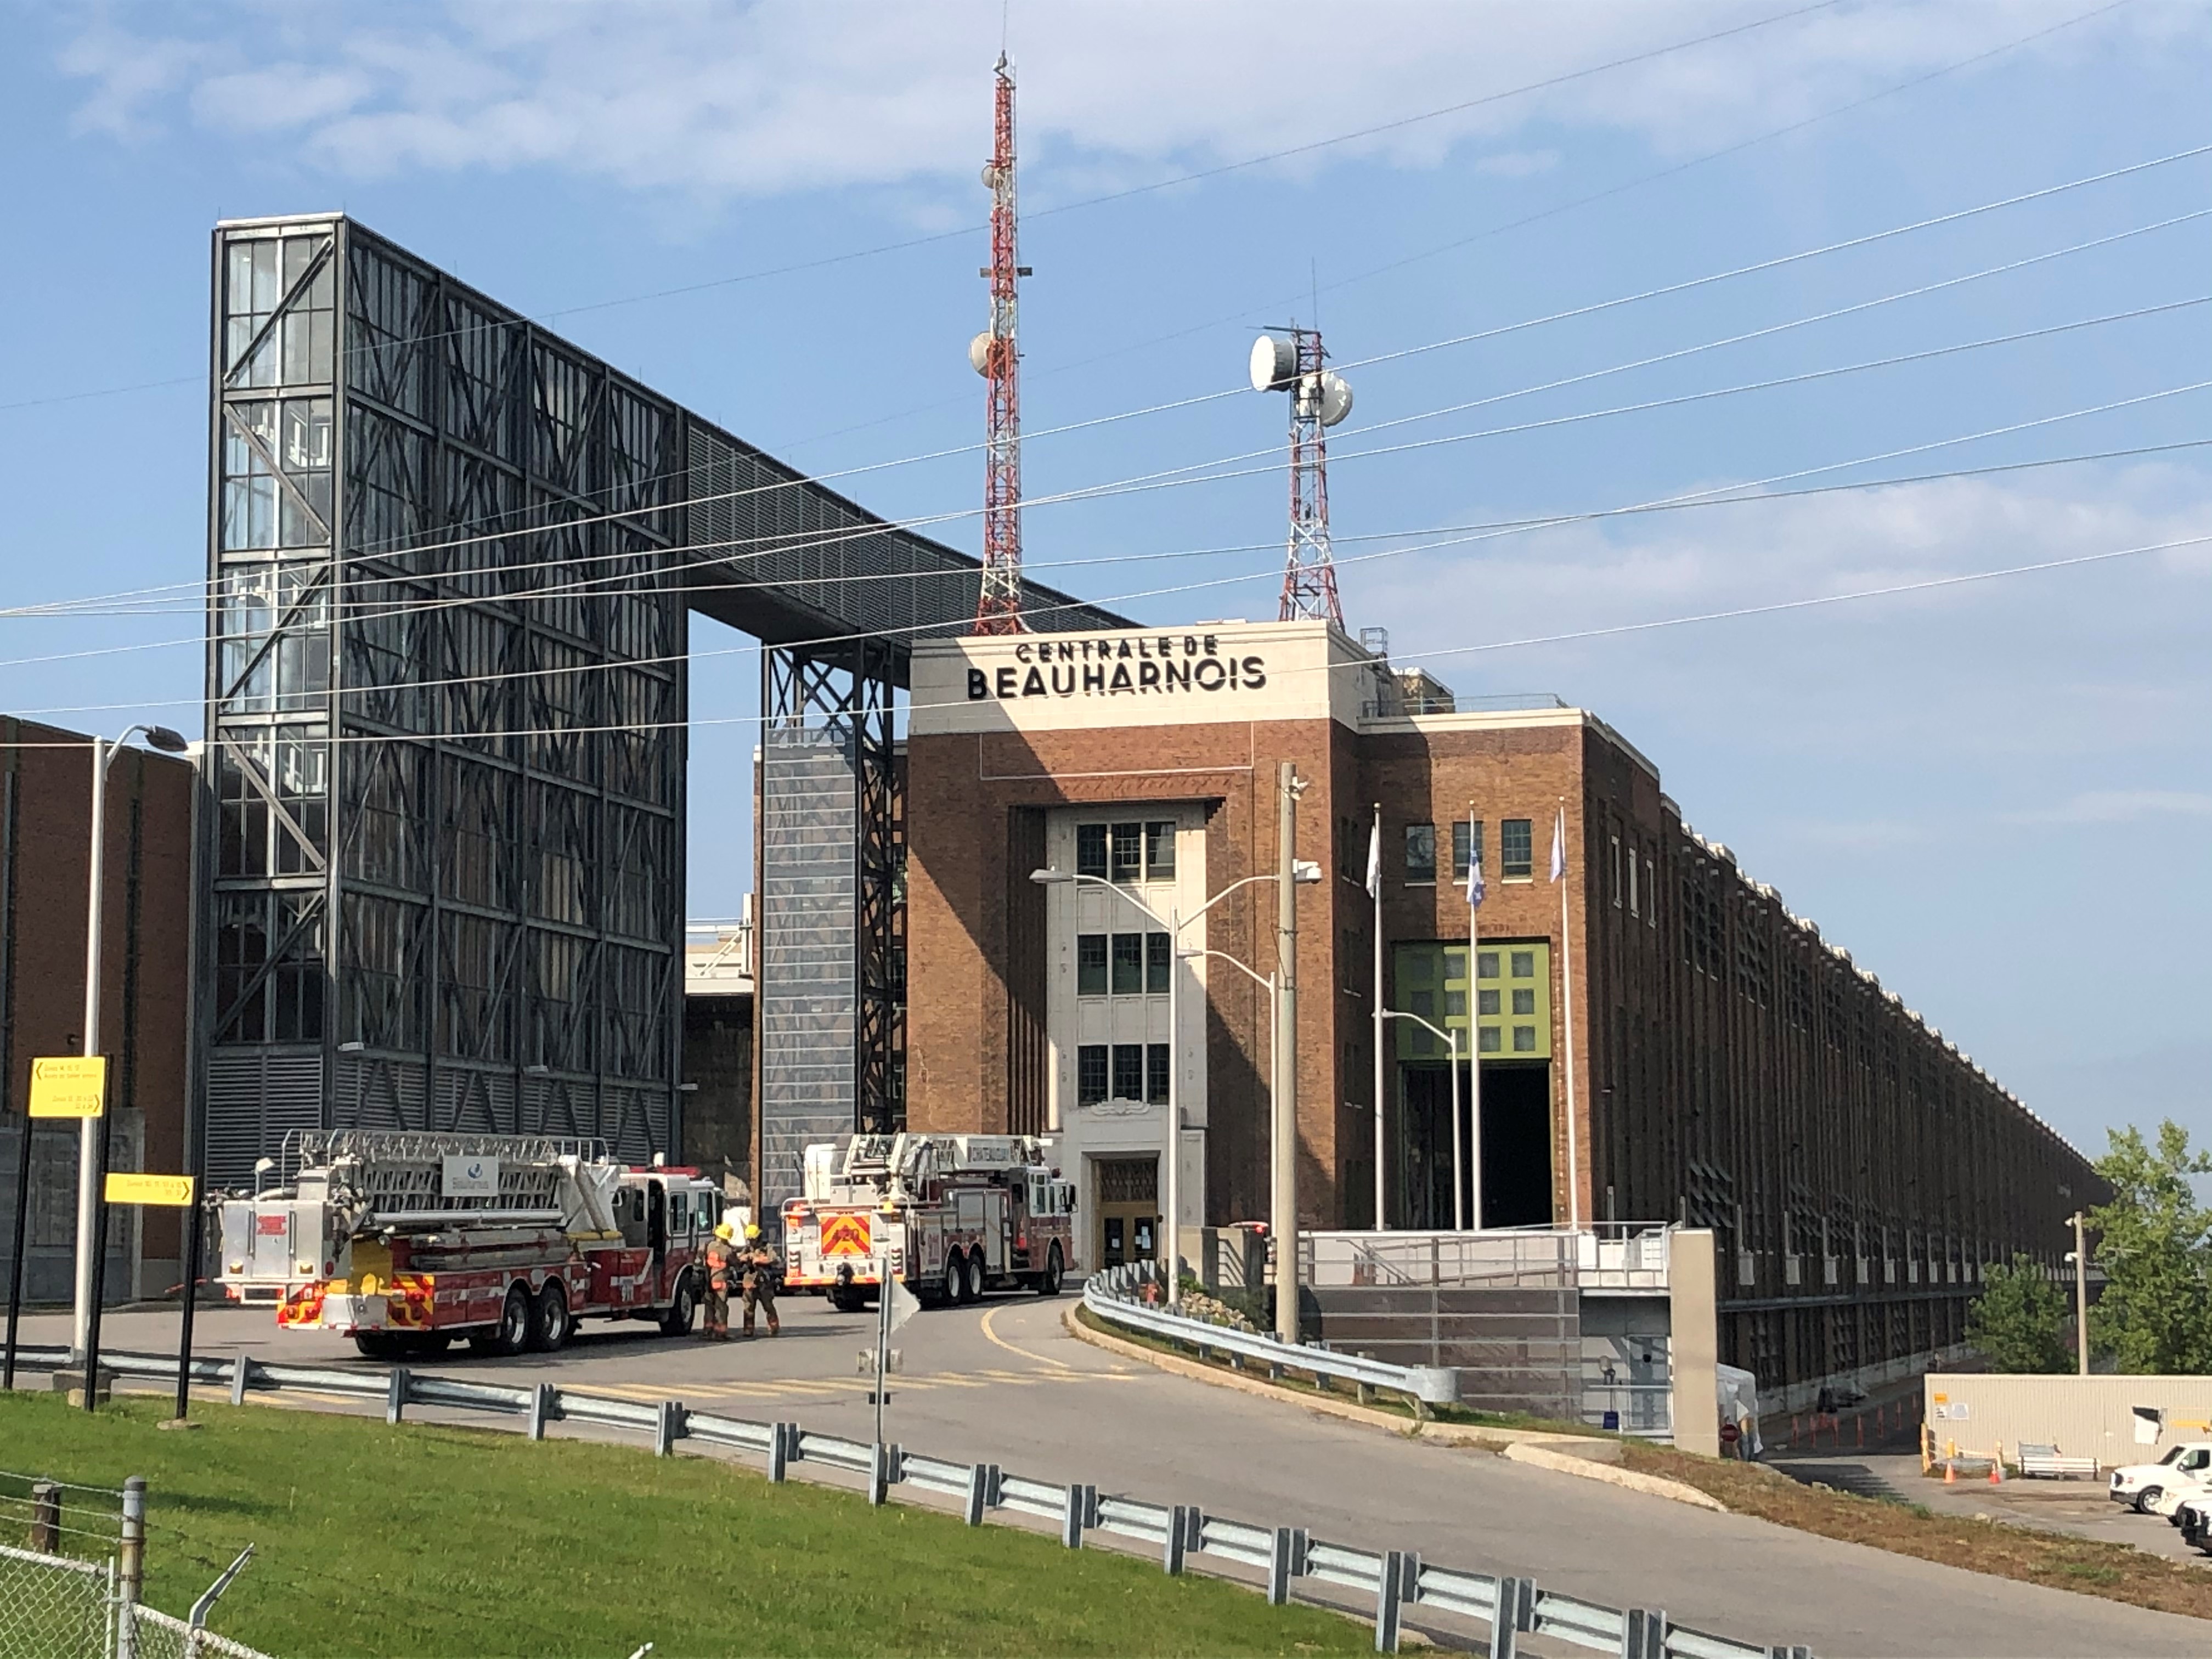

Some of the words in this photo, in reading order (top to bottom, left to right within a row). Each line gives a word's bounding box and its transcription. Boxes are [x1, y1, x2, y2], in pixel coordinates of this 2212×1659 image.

[1015, 636, 1173, 664] CENTRALE
[1184, 635, 1218, 656] DE
[967, 656, 1266, 699] BEAUHARNOIS
